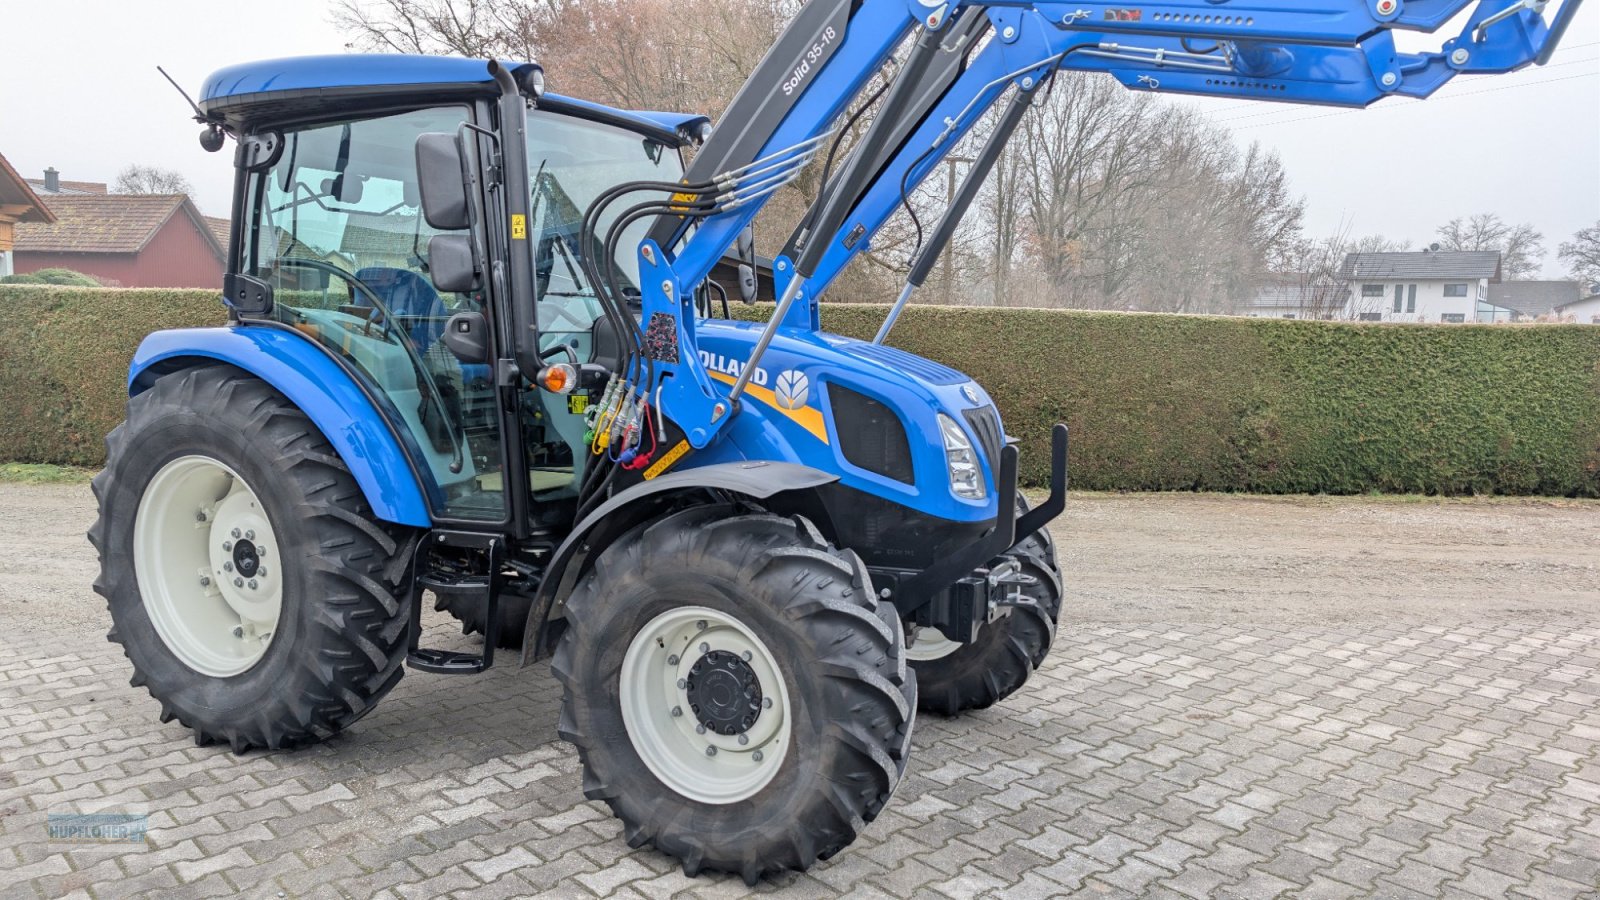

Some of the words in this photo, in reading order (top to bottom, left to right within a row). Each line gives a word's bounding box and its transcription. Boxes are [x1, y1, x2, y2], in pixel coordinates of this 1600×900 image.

[782, 59, 810, 95] Solid
[807, 26, 836, 63] 35-18
[698, 350, 768, 386] OLLAD
